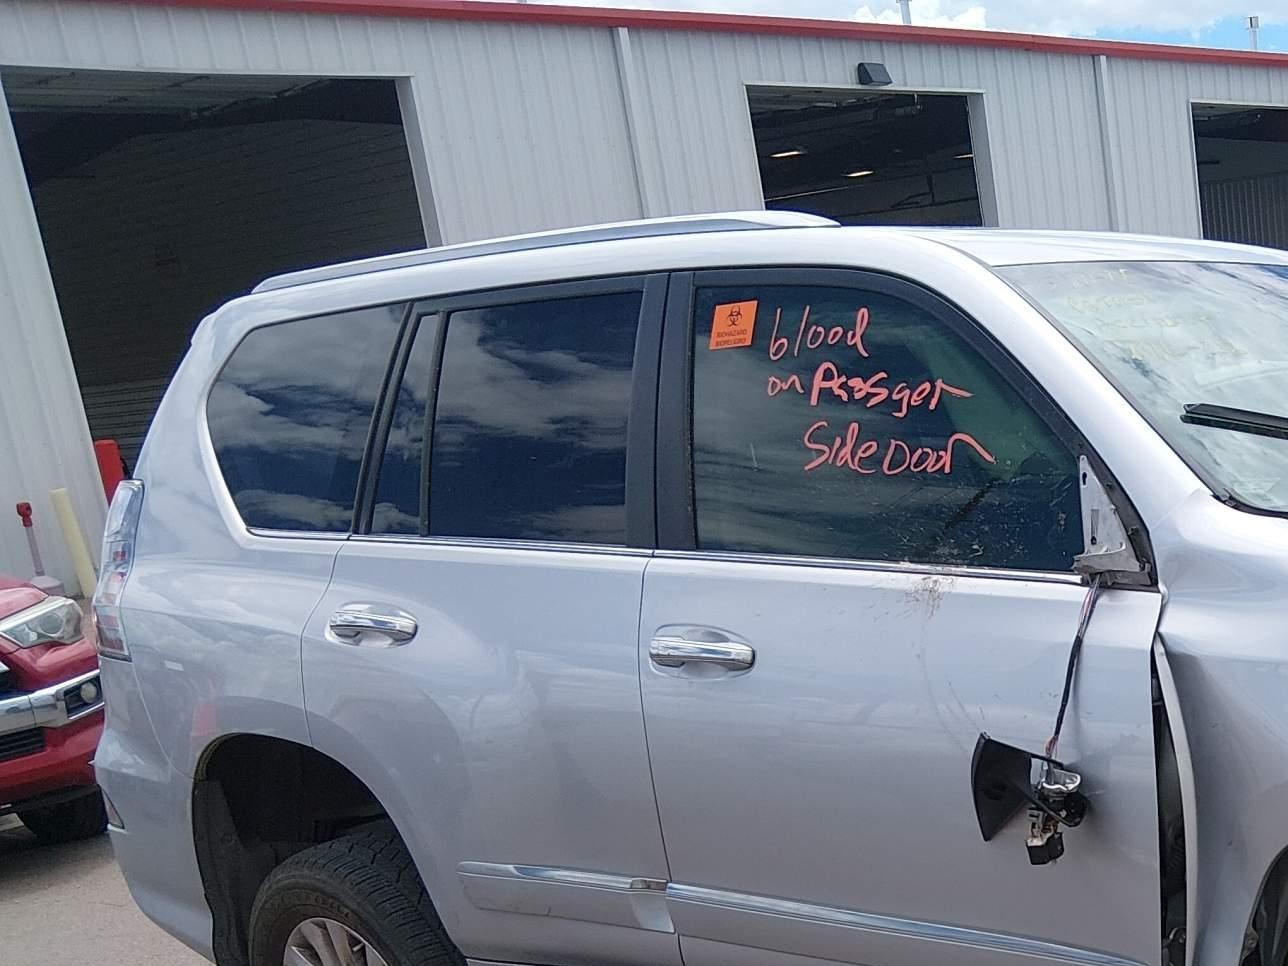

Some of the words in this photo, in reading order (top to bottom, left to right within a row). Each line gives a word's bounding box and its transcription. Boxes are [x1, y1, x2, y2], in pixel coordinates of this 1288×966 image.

[769, 305, 869, 360] blood
[767, 374, 804, 397] on
[803, 420, 878, 474] Side
